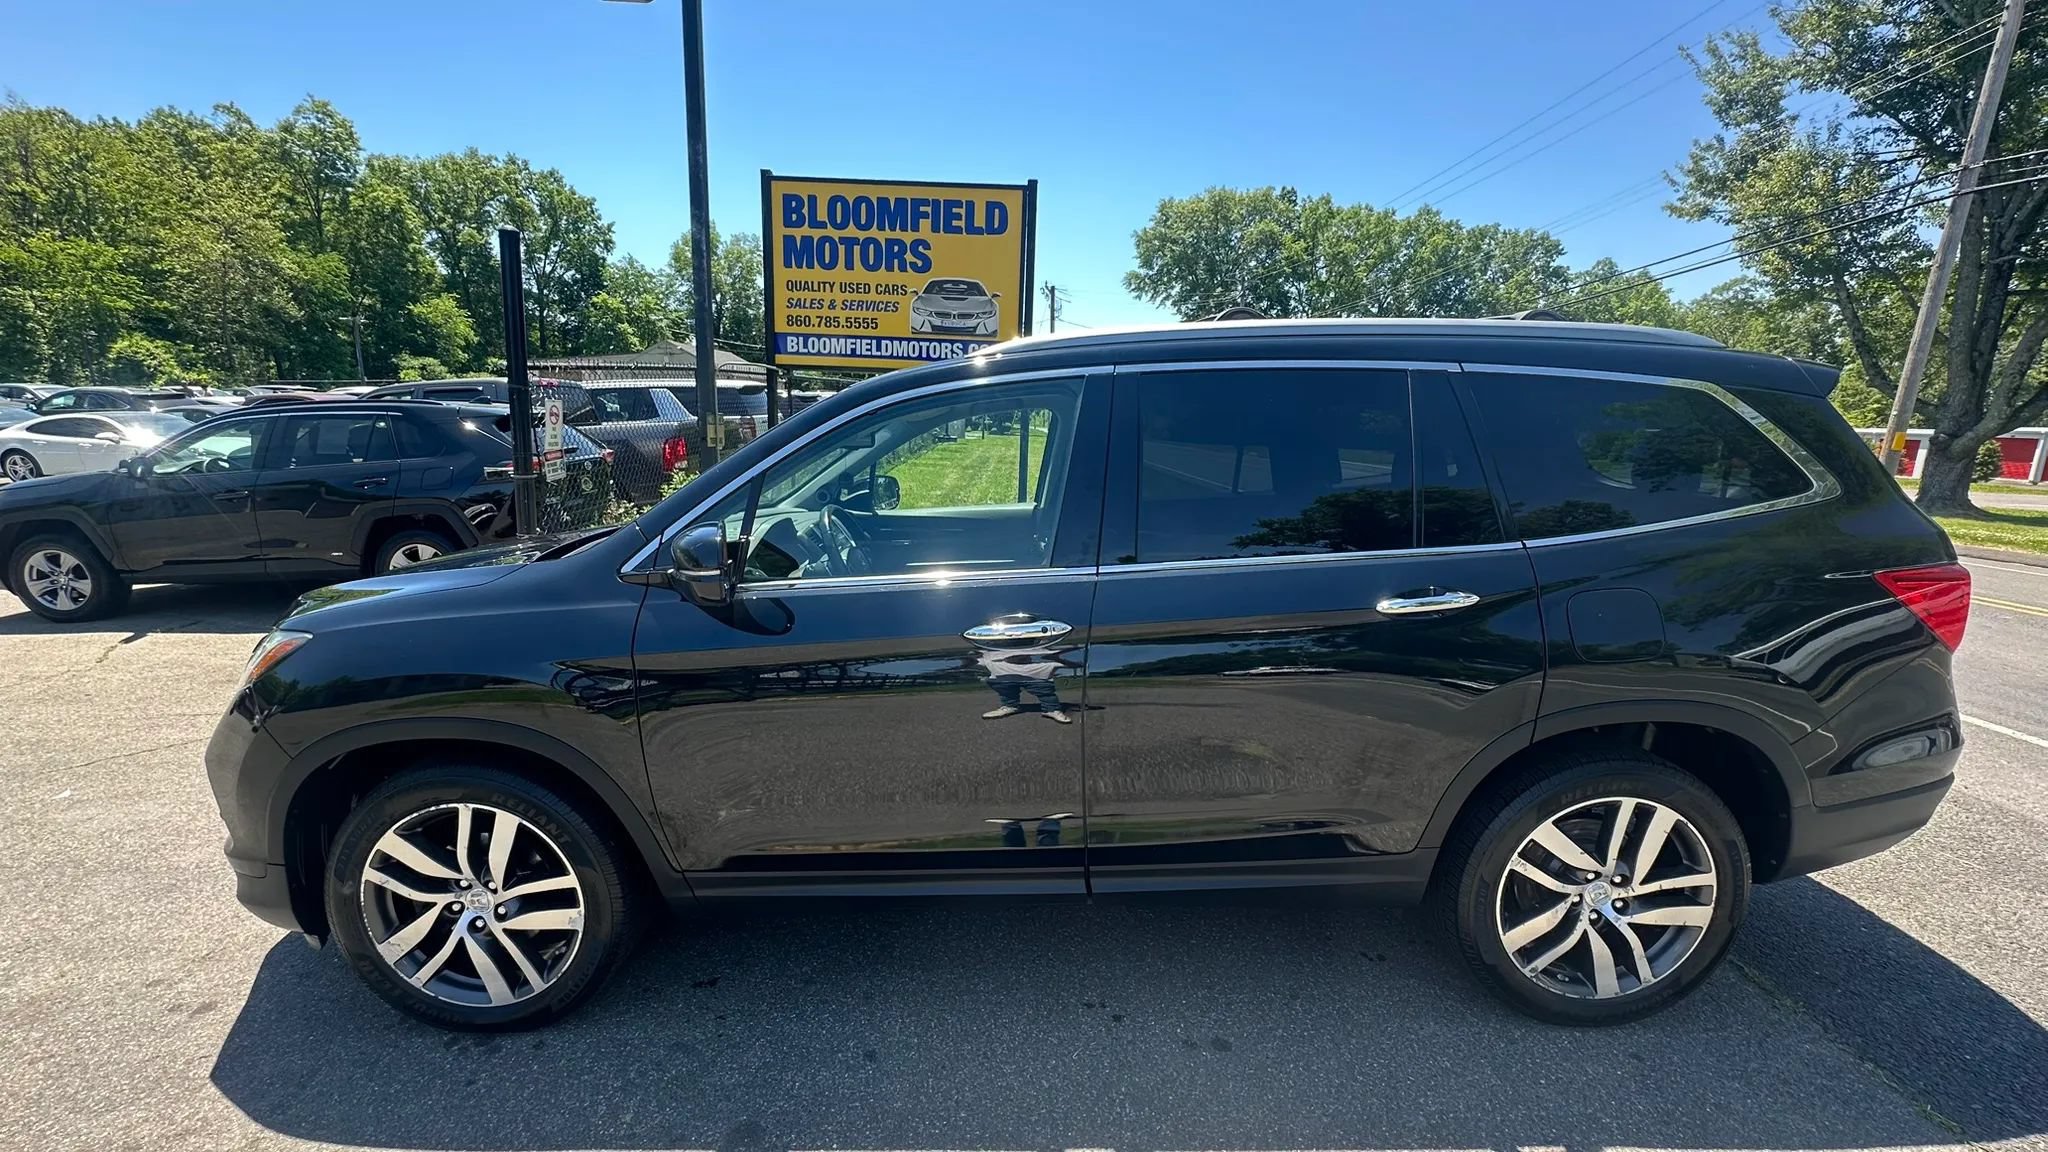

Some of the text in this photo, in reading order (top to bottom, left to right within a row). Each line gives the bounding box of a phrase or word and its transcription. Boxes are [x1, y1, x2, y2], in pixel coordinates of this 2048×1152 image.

[782, 193, 1008, 235] BLOOMFIELD
[782, 235, 932, 274] MOTORS
[786, 280, 908, 296] QUALITY USED CARS
[786, 298, 900, 313] SALES & SERVICES
[786, 314, 879, 330] 860.785.5555
